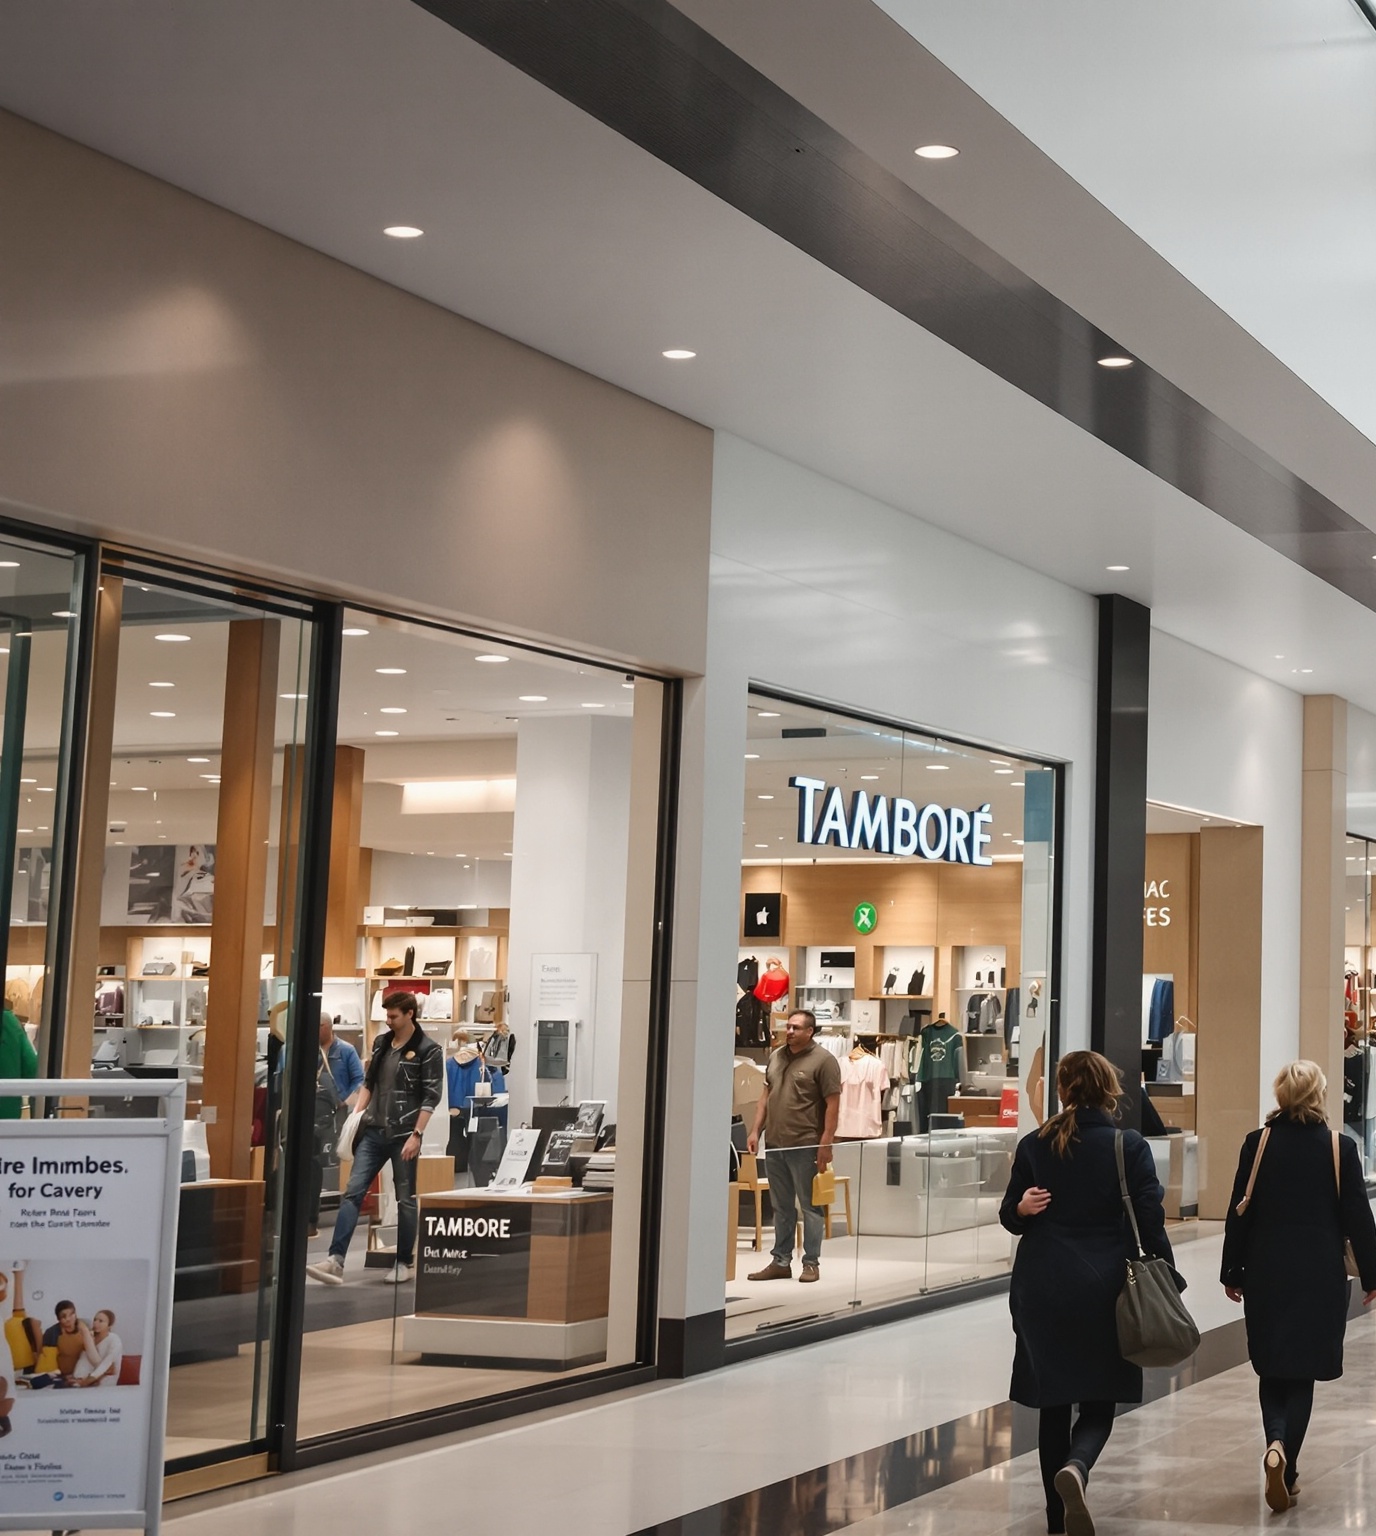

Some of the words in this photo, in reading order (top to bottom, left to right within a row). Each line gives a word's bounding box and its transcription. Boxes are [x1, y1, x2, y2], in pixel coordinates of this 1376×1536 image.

[790, 776, 993, 866] TAMBORÉ
[1144, 880, 1170, 898] AC
[1143, 907, 1171, 927] ES
[8, 1182, 35, 1198] for
[40, 1183, 103, 1200] Cavery
[425, 1216, 511, 1239] TAMBORE
